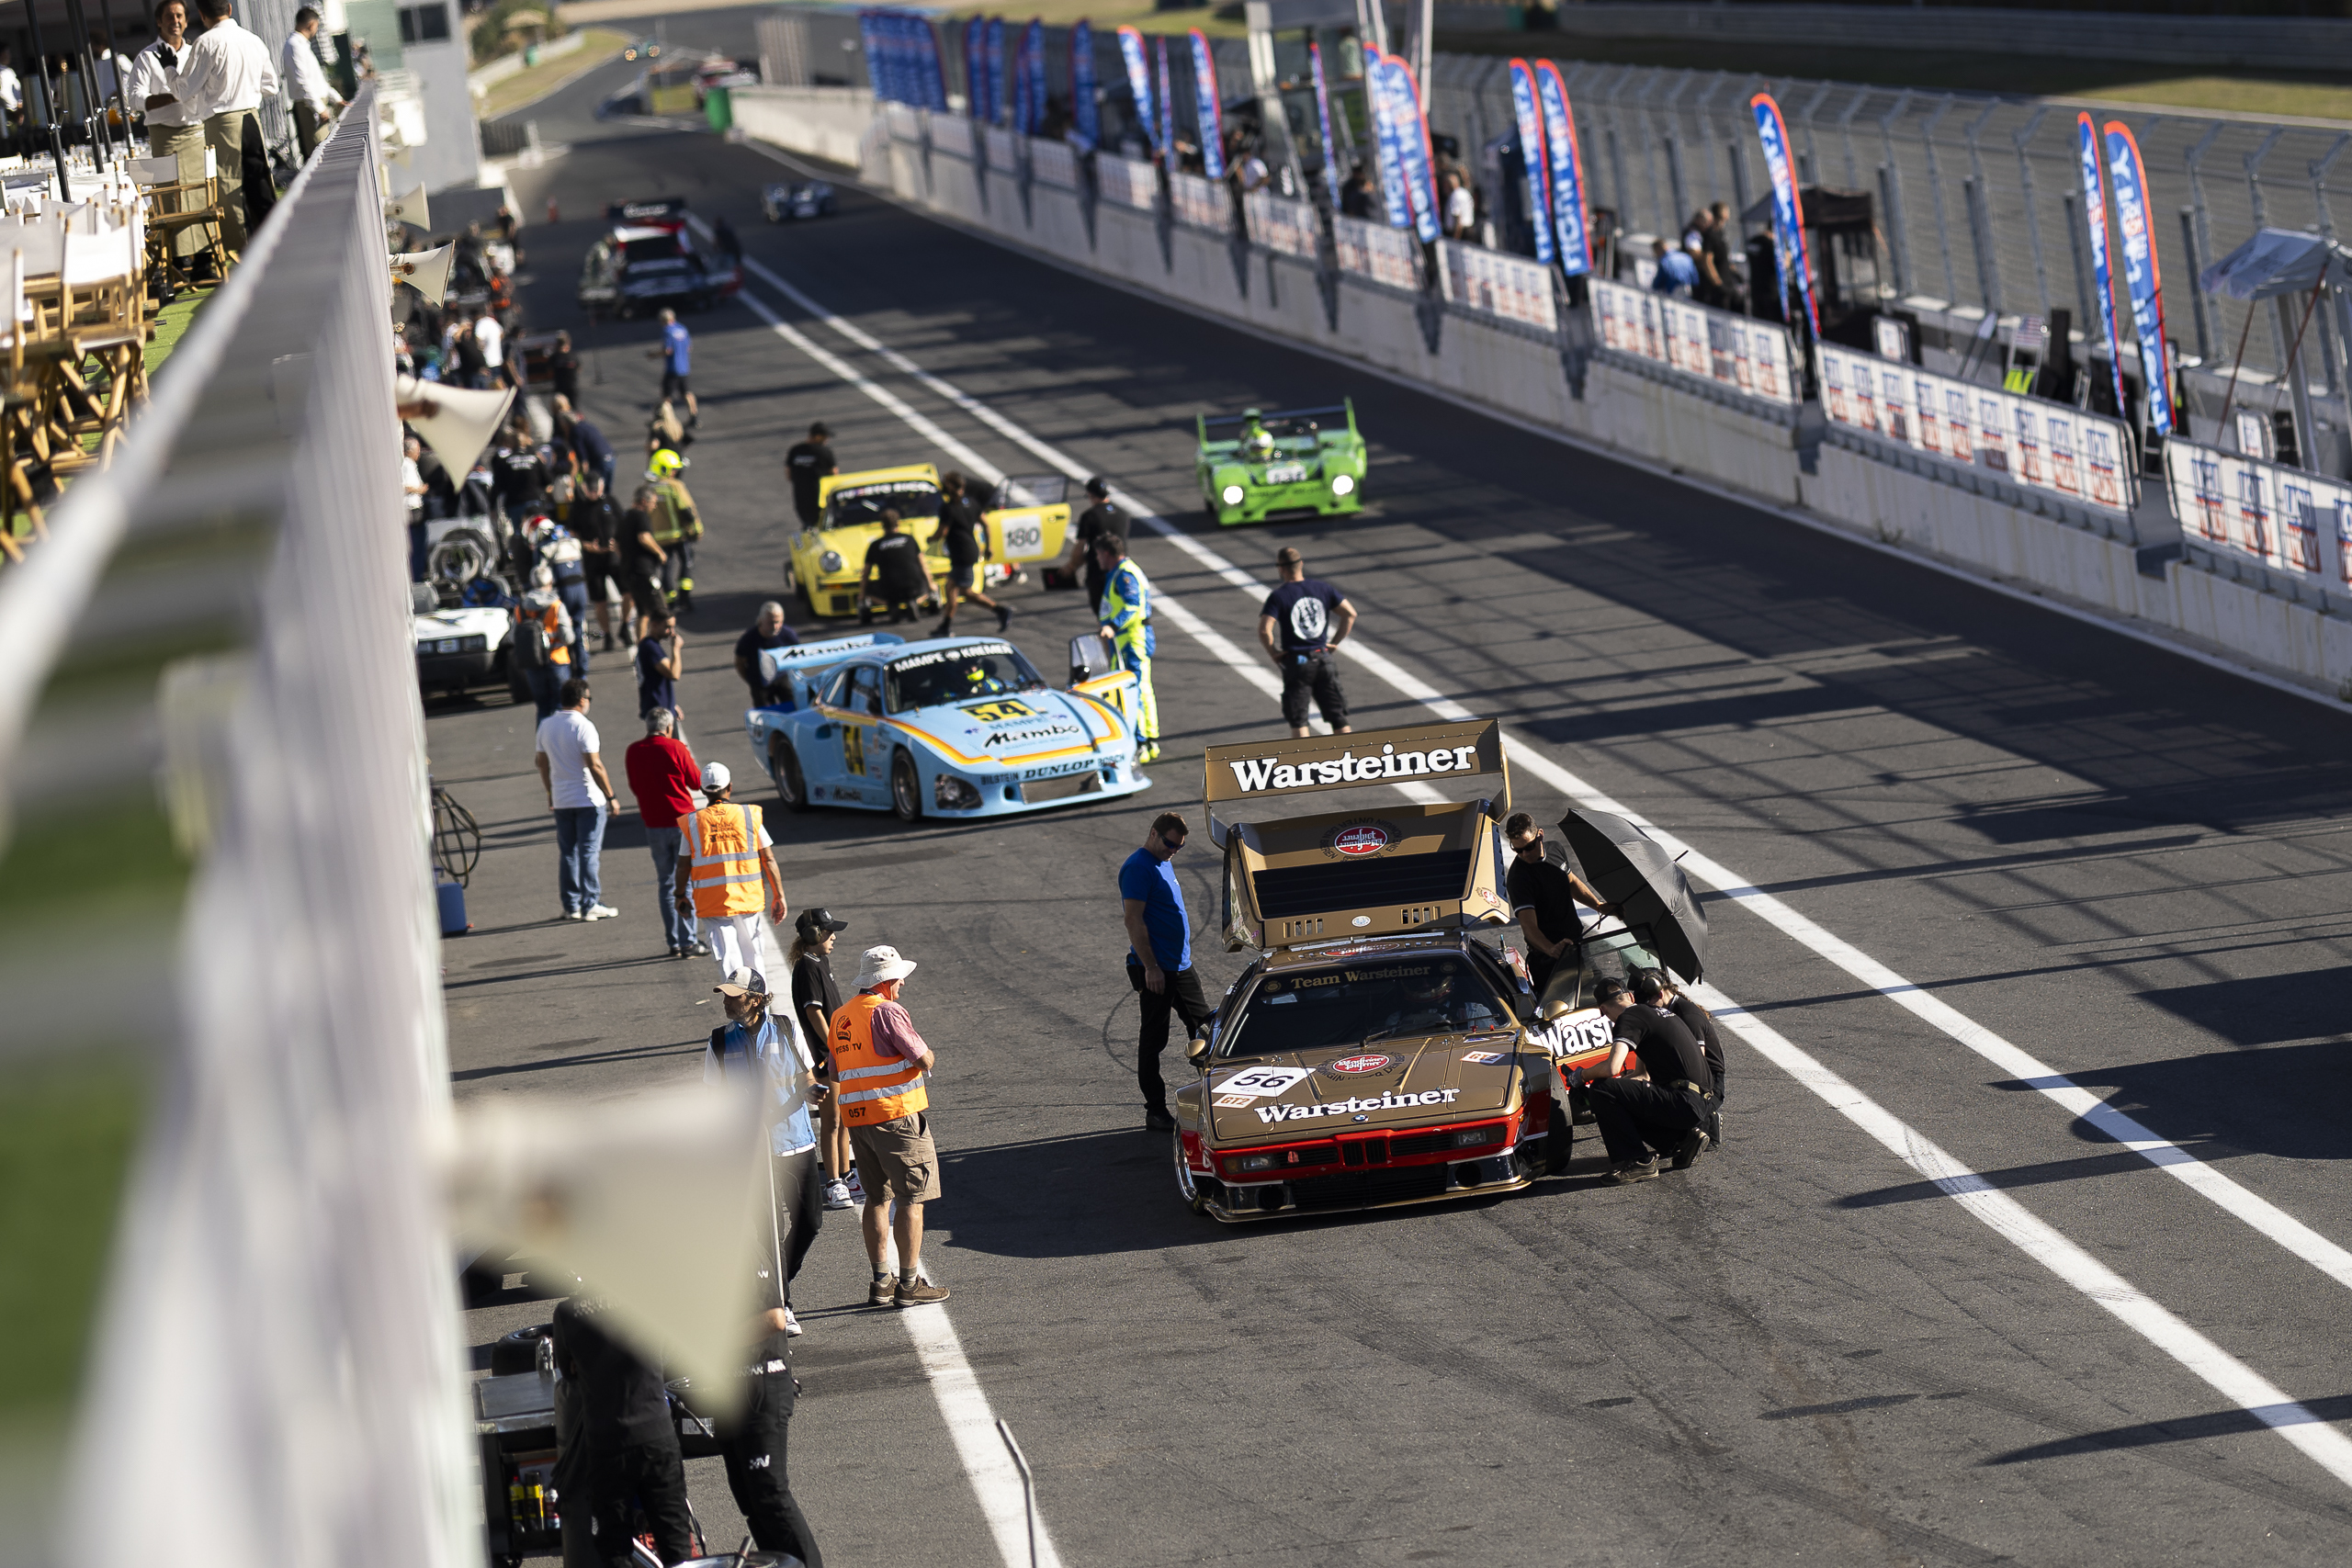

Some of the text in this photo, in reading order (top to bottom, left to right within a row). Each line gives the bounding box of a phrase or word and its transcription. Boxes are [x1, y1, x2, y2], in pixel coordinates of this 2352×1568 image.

[1005, 526, 1041, 548] 180
[894, 642, 1014, 672] MAMPE KREMER
[965, 703, 1030, 722] 54
[984, 725, 1080, 749] Mambo
[1023, 759, 1094, 779] DUNLOP
[1229, 743, 1476, 793] Warsteiner
[980, 771, 1020, 786] BILSTEIN
[1291, 965, 1430, 989] Team Warsteiner
[852, 1043, 863, 1051] TV
[1234, 1073, 1295, 1089] 56
[1220, 1097, 1250, 1106] GT2
[1253, 1088, 1462, 1124] Warsteiner
[848, 1107, 866, 1119] 057
